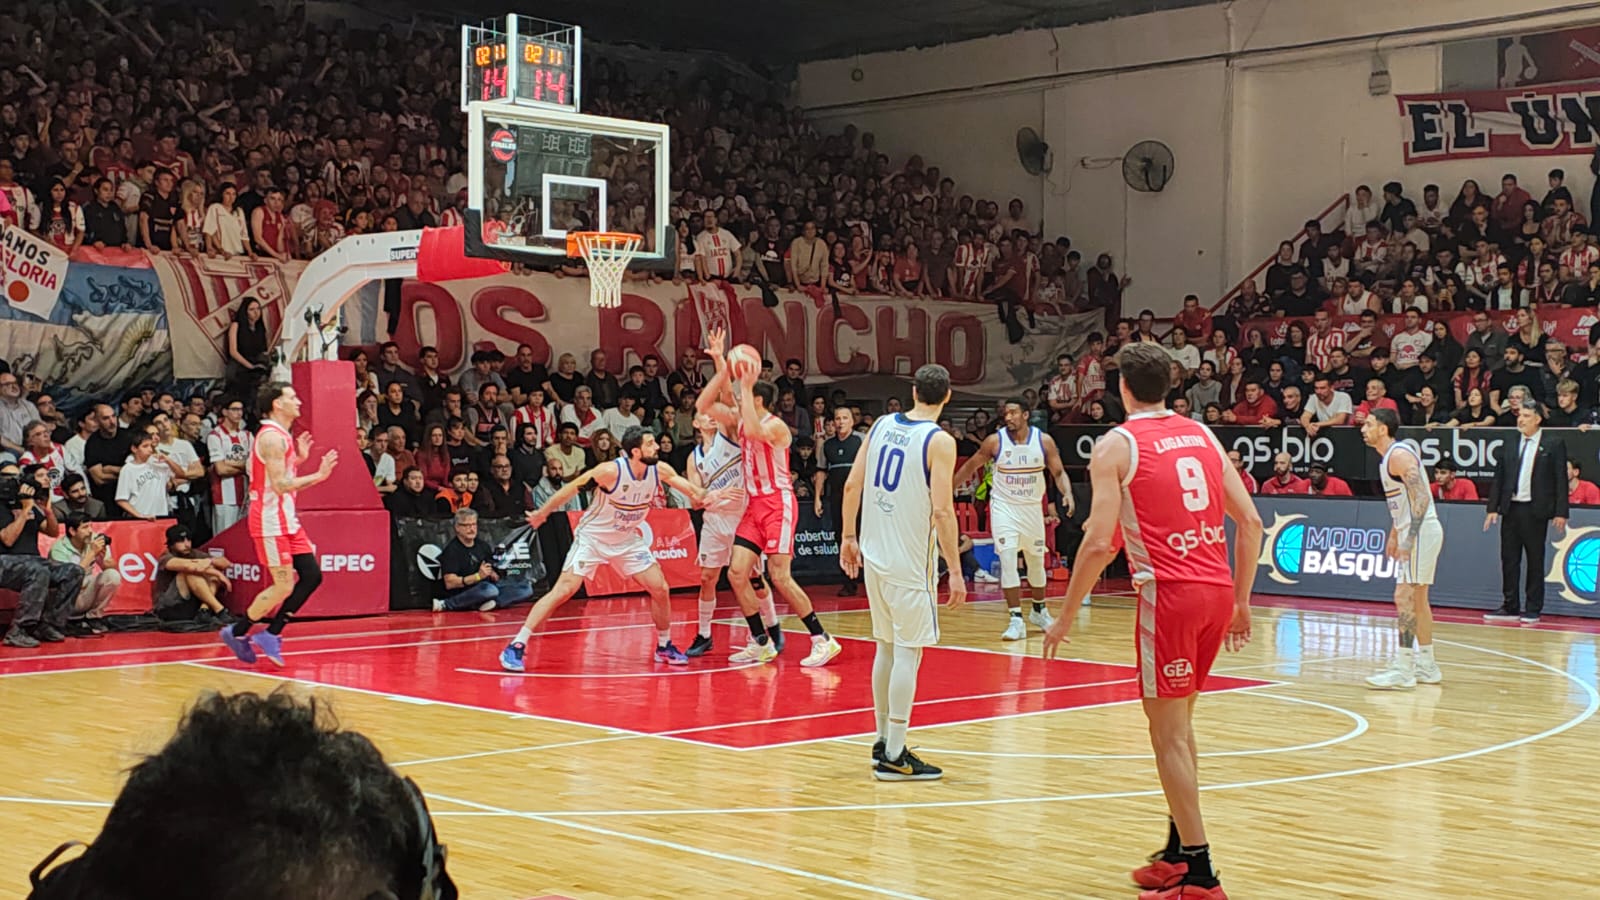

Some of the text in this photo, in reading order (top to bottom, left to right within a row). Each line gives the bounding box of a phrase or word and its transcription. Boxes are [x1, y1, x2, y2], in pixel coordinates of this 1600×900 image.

[524, 43, 543, 64] 02
[482, 65, 508, 101] 14
[534, 68, 567, 105] 14
[1408, 101, 1487, 153] EL
[1153, 435, 1208, 454] LUGARINI
[873, 444, 905, 492] 10
[1175, 455, 1210, 512] 9
[798, 541, 839, 556] de salud
[1305, 526, 1386, 553] MODO
[225, 563, 261, 582] EPEC
[320, 554, 375, 571] EPEC
[1162, 662, 1194, 678] GEA
